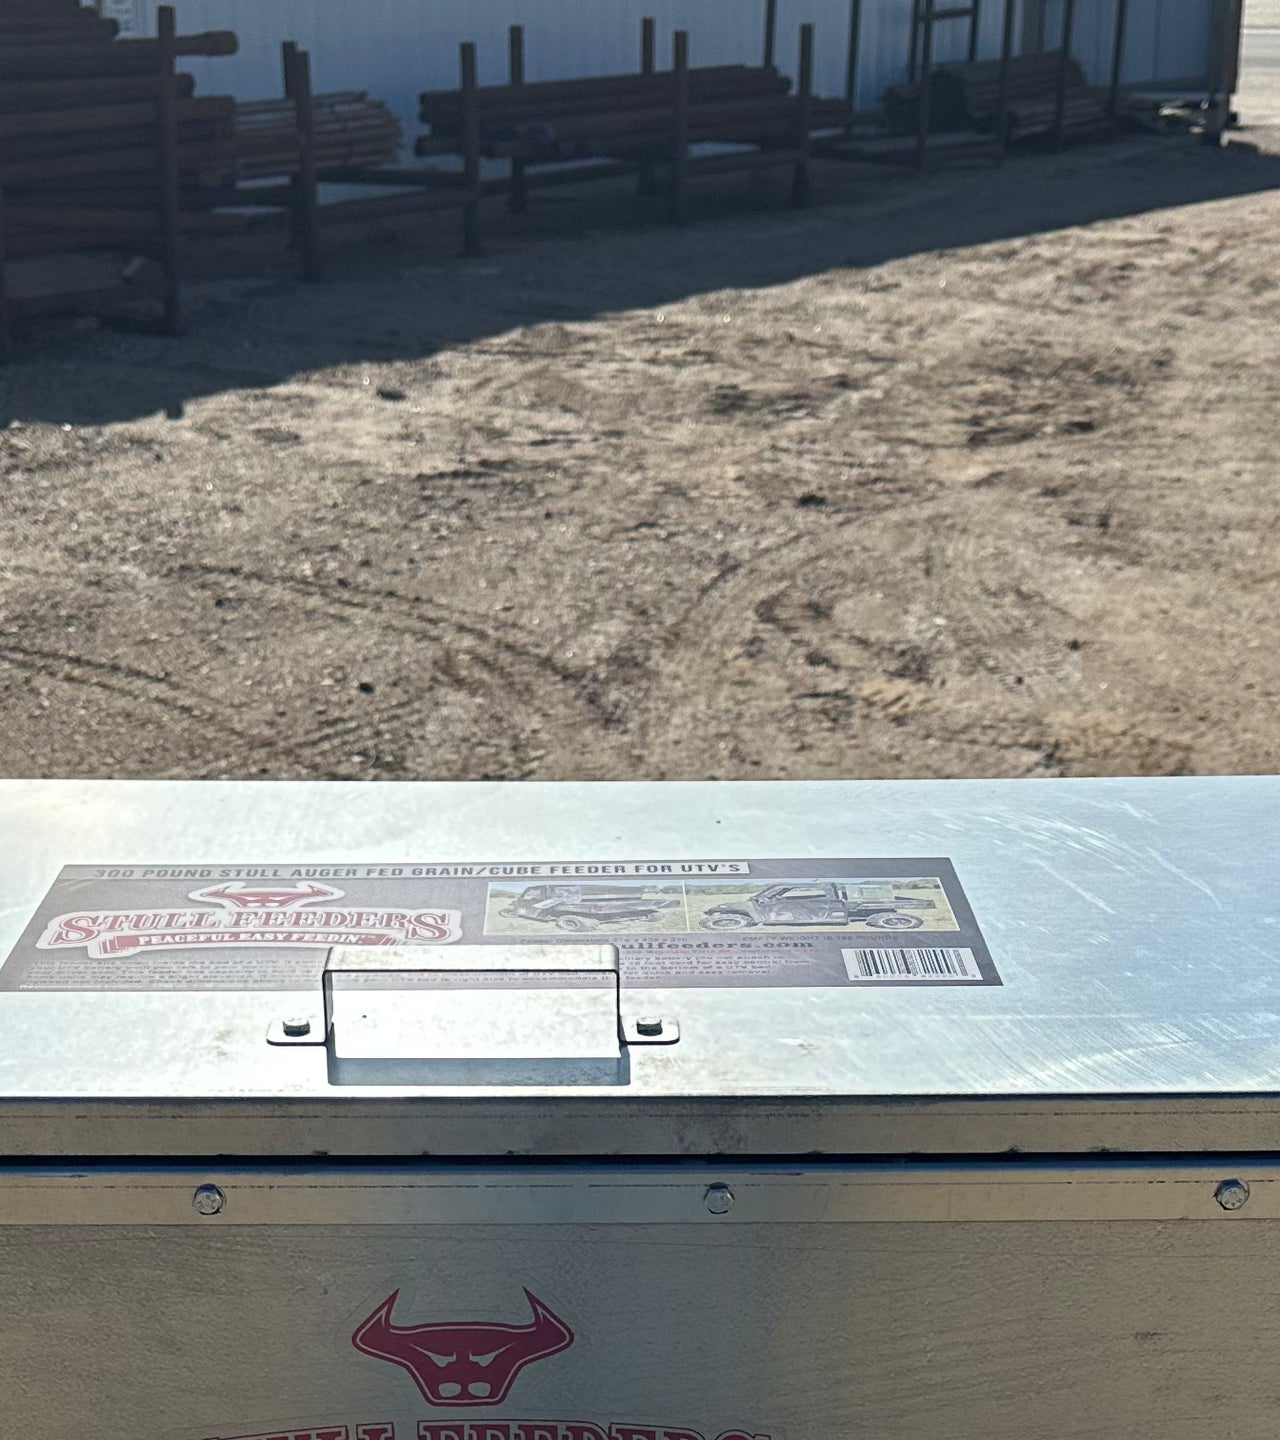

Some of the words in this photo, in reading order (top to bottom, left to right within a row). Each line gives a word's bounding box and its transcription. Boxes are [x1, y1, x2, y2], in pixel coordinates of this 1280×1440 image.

[94, 868, 135, 879] 300
[141, 868, 212, 878] POUND
[219, 868, 283, 878] STULL
[289, 867, 358, 877] AUGER
[365, 867, 404, 877] FED
[411, 865, 542, 876] GRAIN/CUBE
[549, 865, 627, 875] FEEDER
[634, 864, 673, 874] FOR
[680, 862, 742, 873] UTV'S
[49, 911, 222, 945] STULL
[224, 911, 450, 942] FEEDERS
[137, 933, 235, 946] PEACEFUL
[238, 933, 289, 942] EASY
